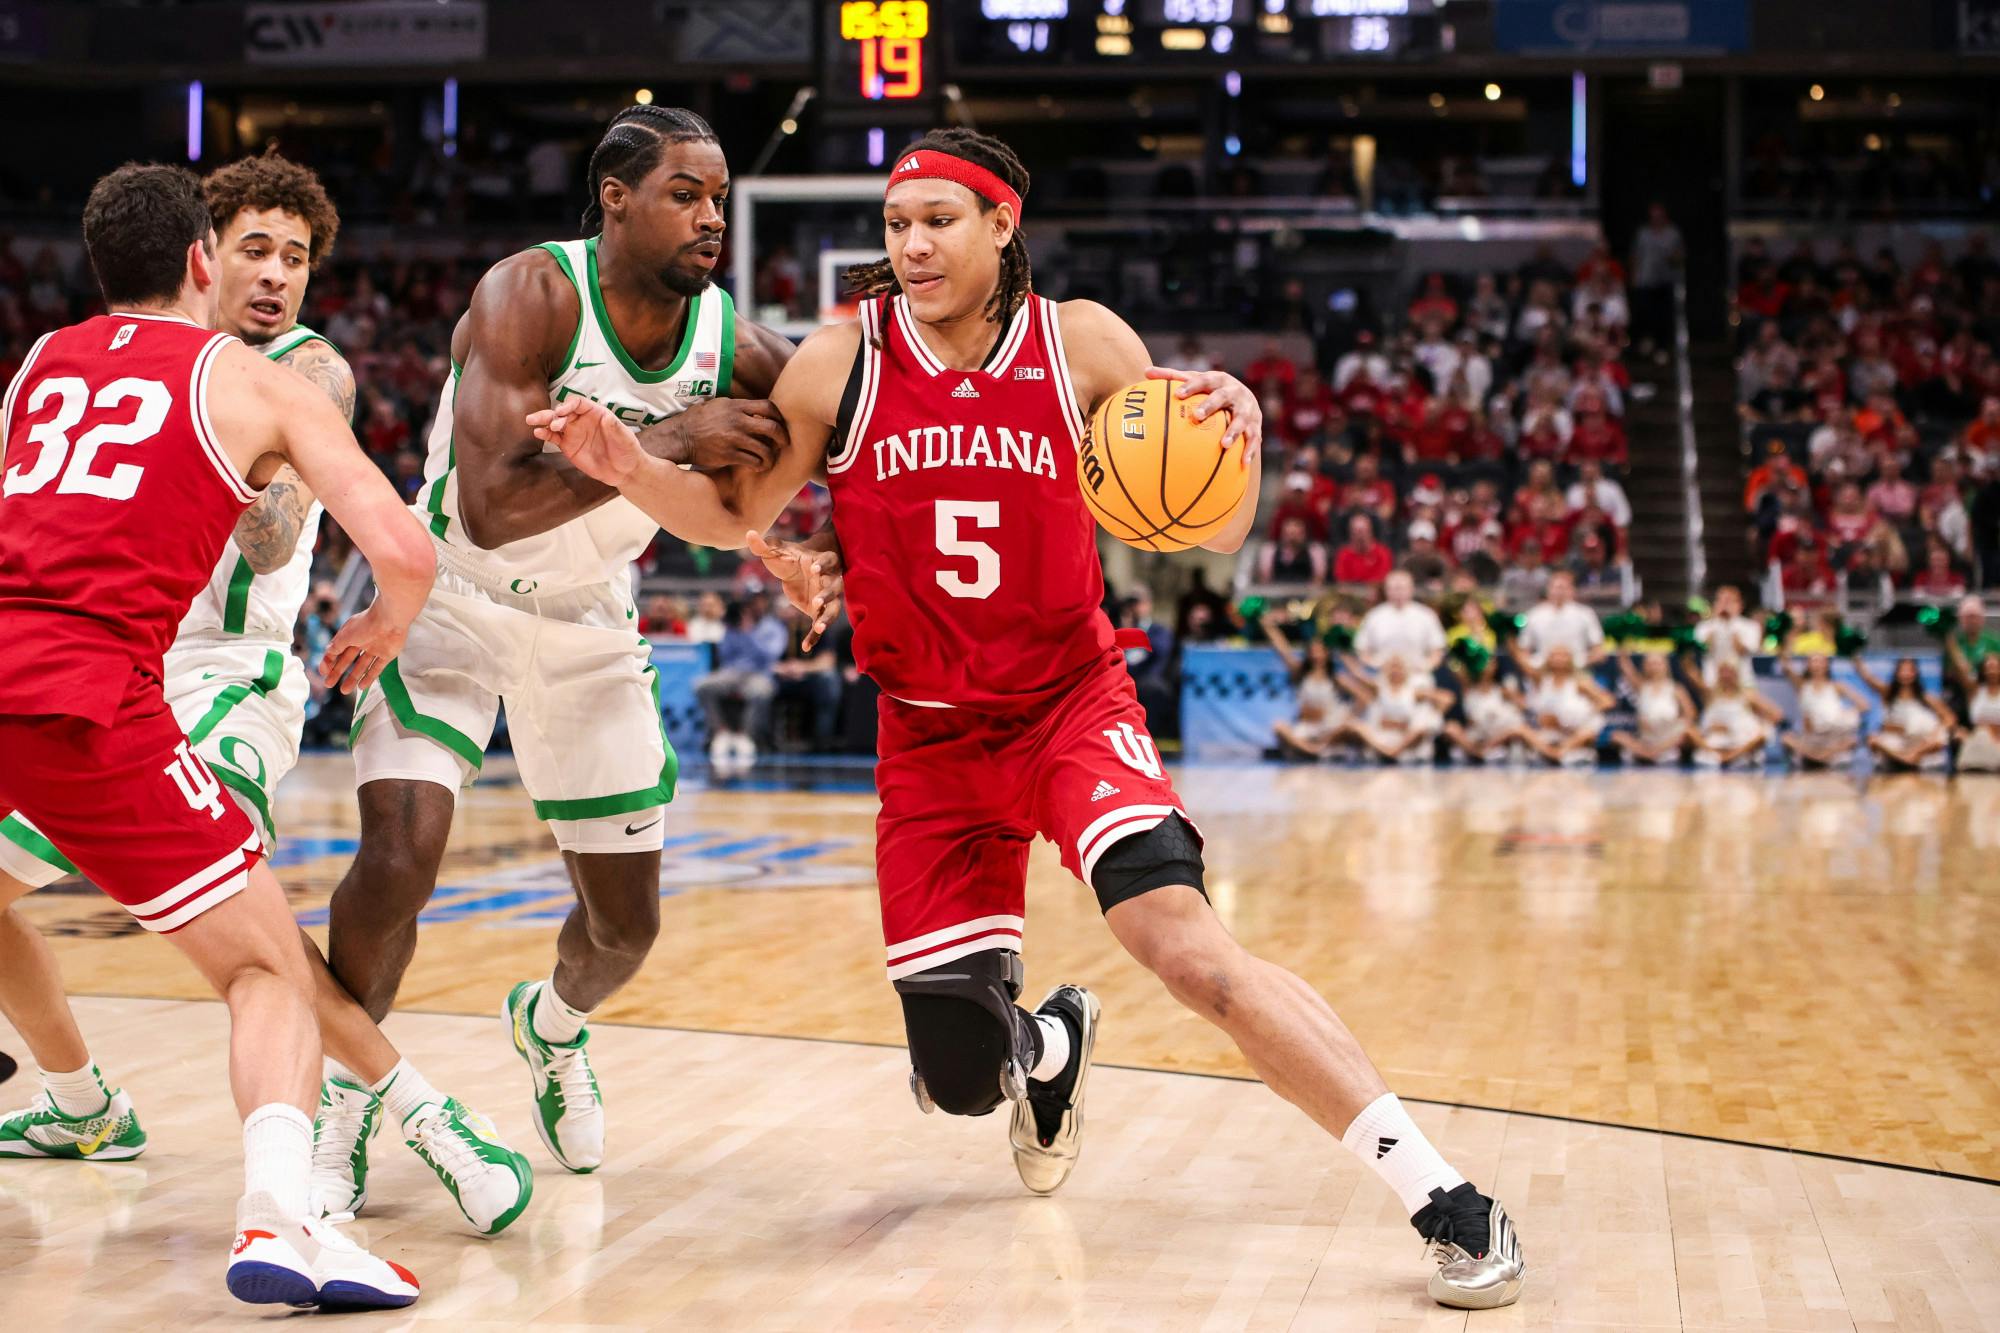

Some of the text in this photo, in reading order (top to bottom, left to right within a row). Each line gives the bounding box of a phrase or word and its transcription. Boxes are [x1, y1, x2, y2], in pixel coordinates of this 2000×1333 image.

[861, 39, 922, 98] 19
[951, 389, 980, 398] adidas
[2, 376, 173, 501] 32
[873, 425, 1058, 482] INDIANA
[934, 499, 1001, 600] 5
[1090, 787, 1121, 802] adidas
